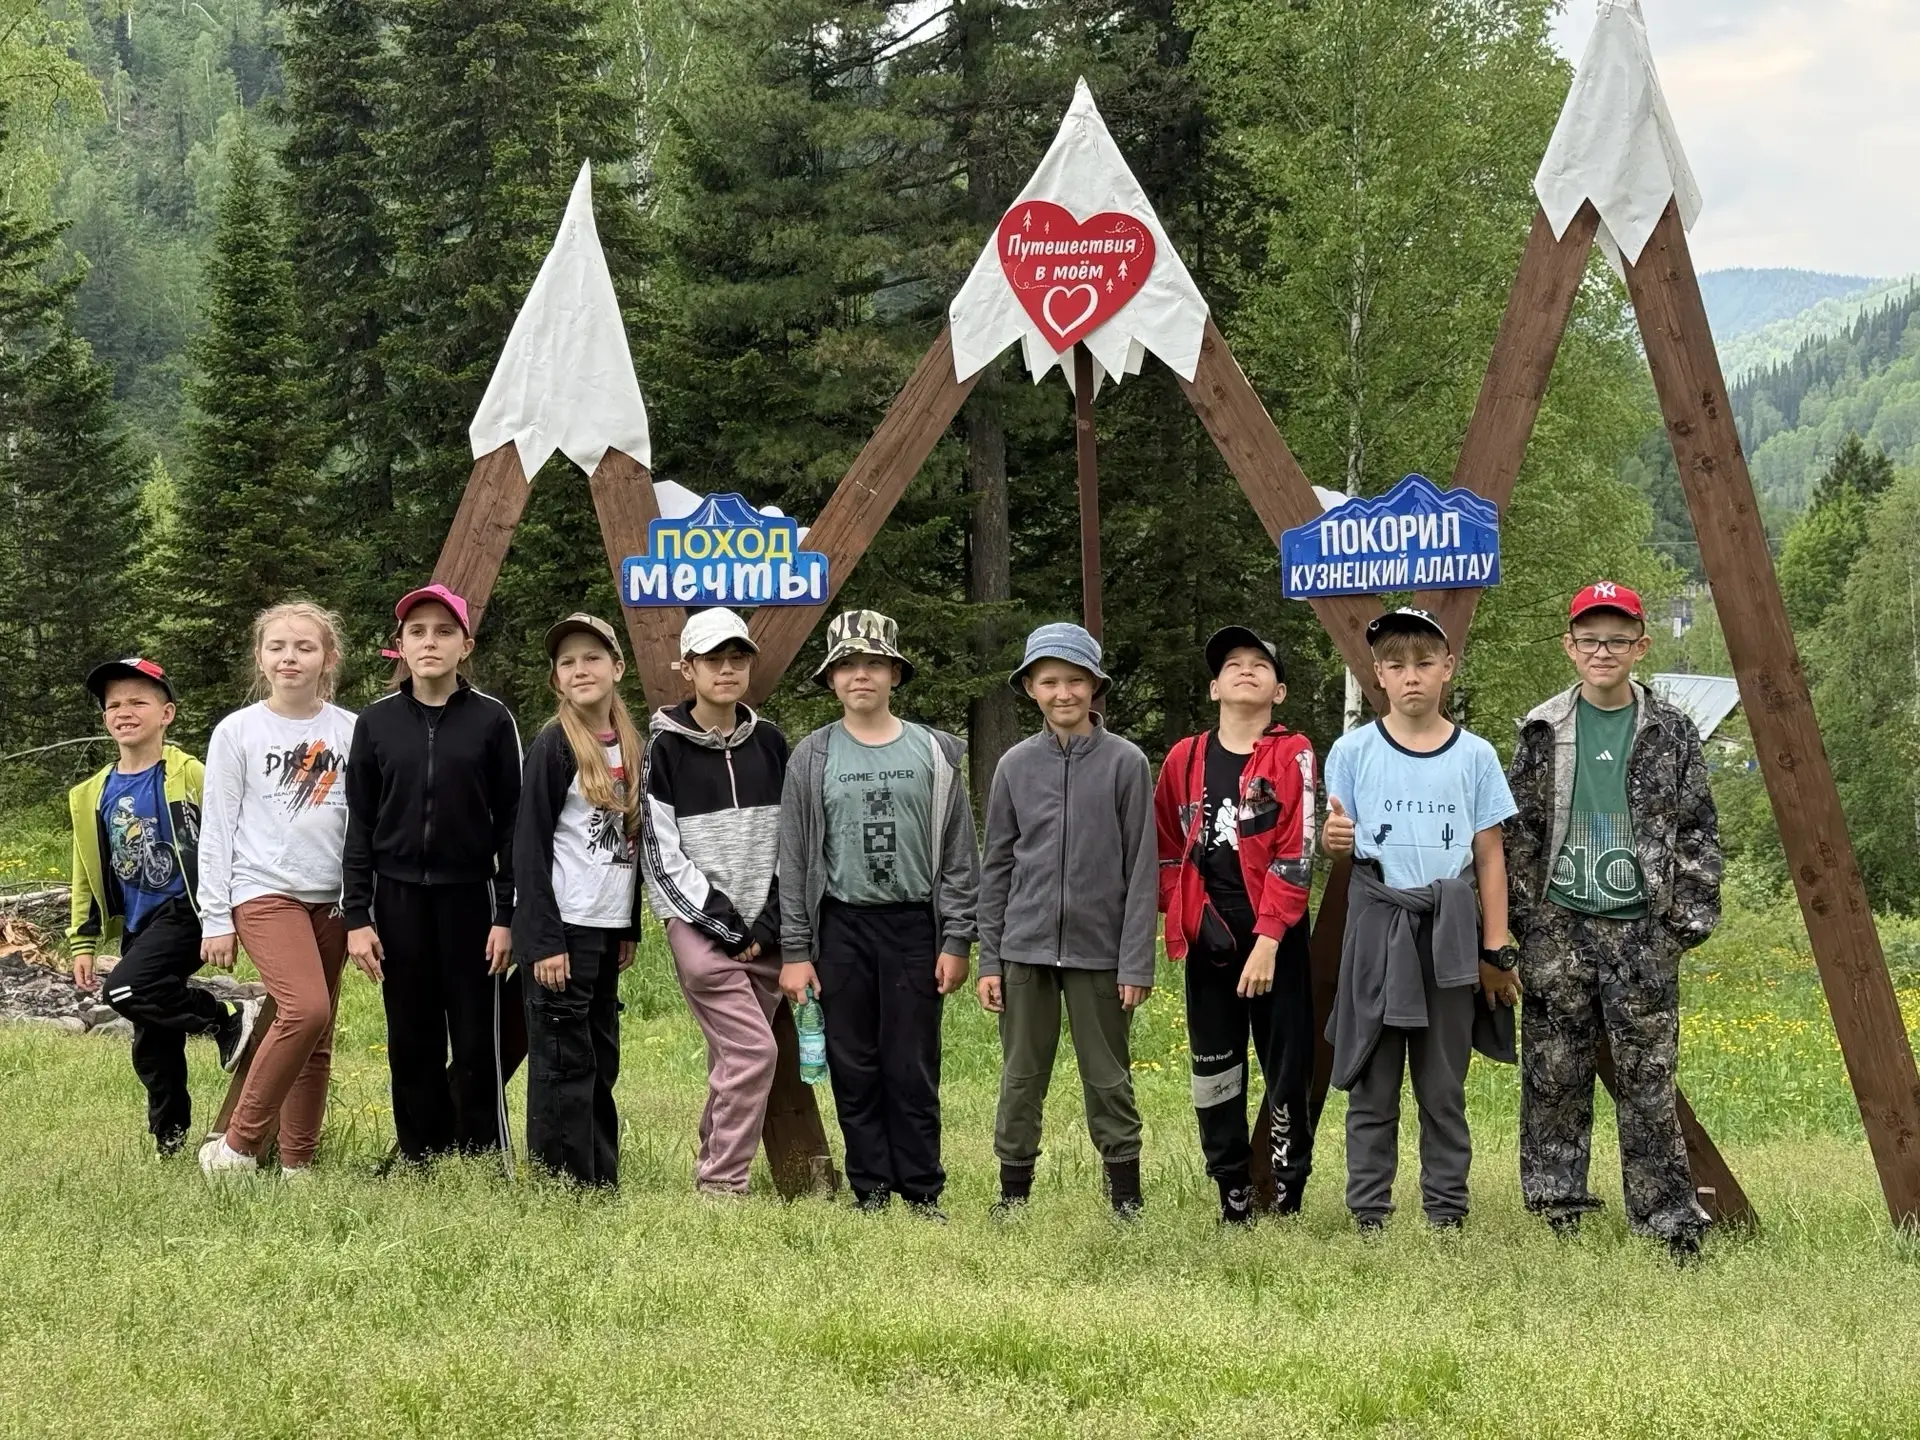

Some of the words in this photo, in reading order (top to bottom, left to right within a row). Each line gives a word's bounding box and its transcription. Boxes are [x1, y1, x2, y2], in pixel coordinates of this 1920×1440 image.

[1007, 233, 1137, 262] Путешествия
[1035, 265, 1046, 281] в
[1053, 260, 1104, 280] моём
[657, 528, 793, 565] ПОХОД
[1320, 511, 1461, 557] ПОКОРИЛ
[1290, 553, 1409, 592] КУЗНЕЦКИЙ
[1414, 552, 1495, 584] АЛАТАУ
[838, 772, 875, 783] GAME
[878, 769, 915, 782] OVER
[1384, 799, 1456, 814] Offline
